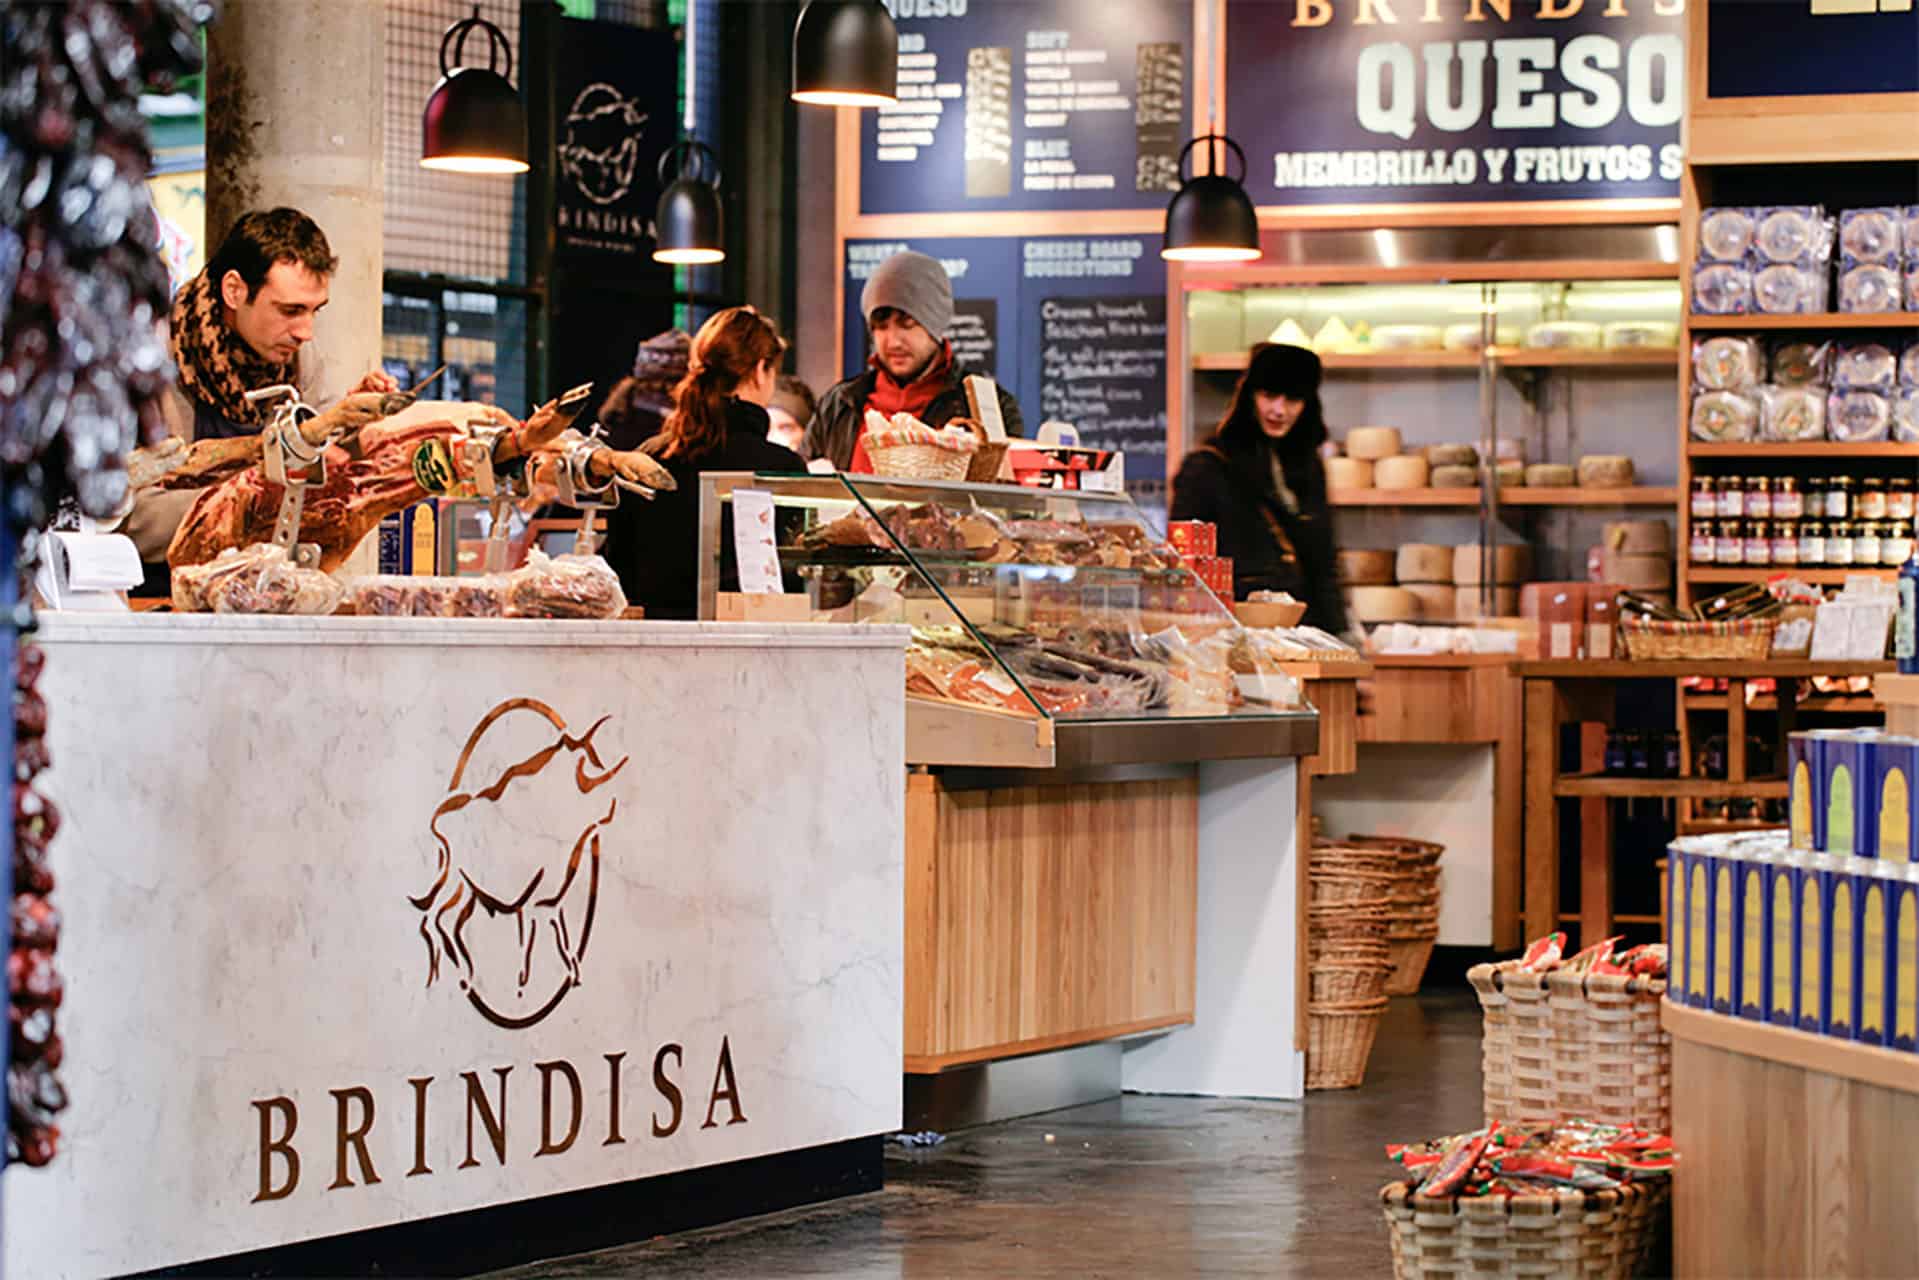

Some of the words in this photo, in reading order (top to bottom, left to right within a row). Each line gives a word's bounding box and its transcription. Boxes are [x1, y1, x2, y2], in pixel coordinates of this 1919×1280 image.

[882, 0, 967, 18] UESO
[1357, 34, 1683, 139] QUESO
[1274, 148, 1477, 187] MEMBRILLO
[1483, 148, 1509, 183] Y
[1514, 144, 1652, 183] FRUTOS
[251, 1035, 748, 1204] BRINDISA
